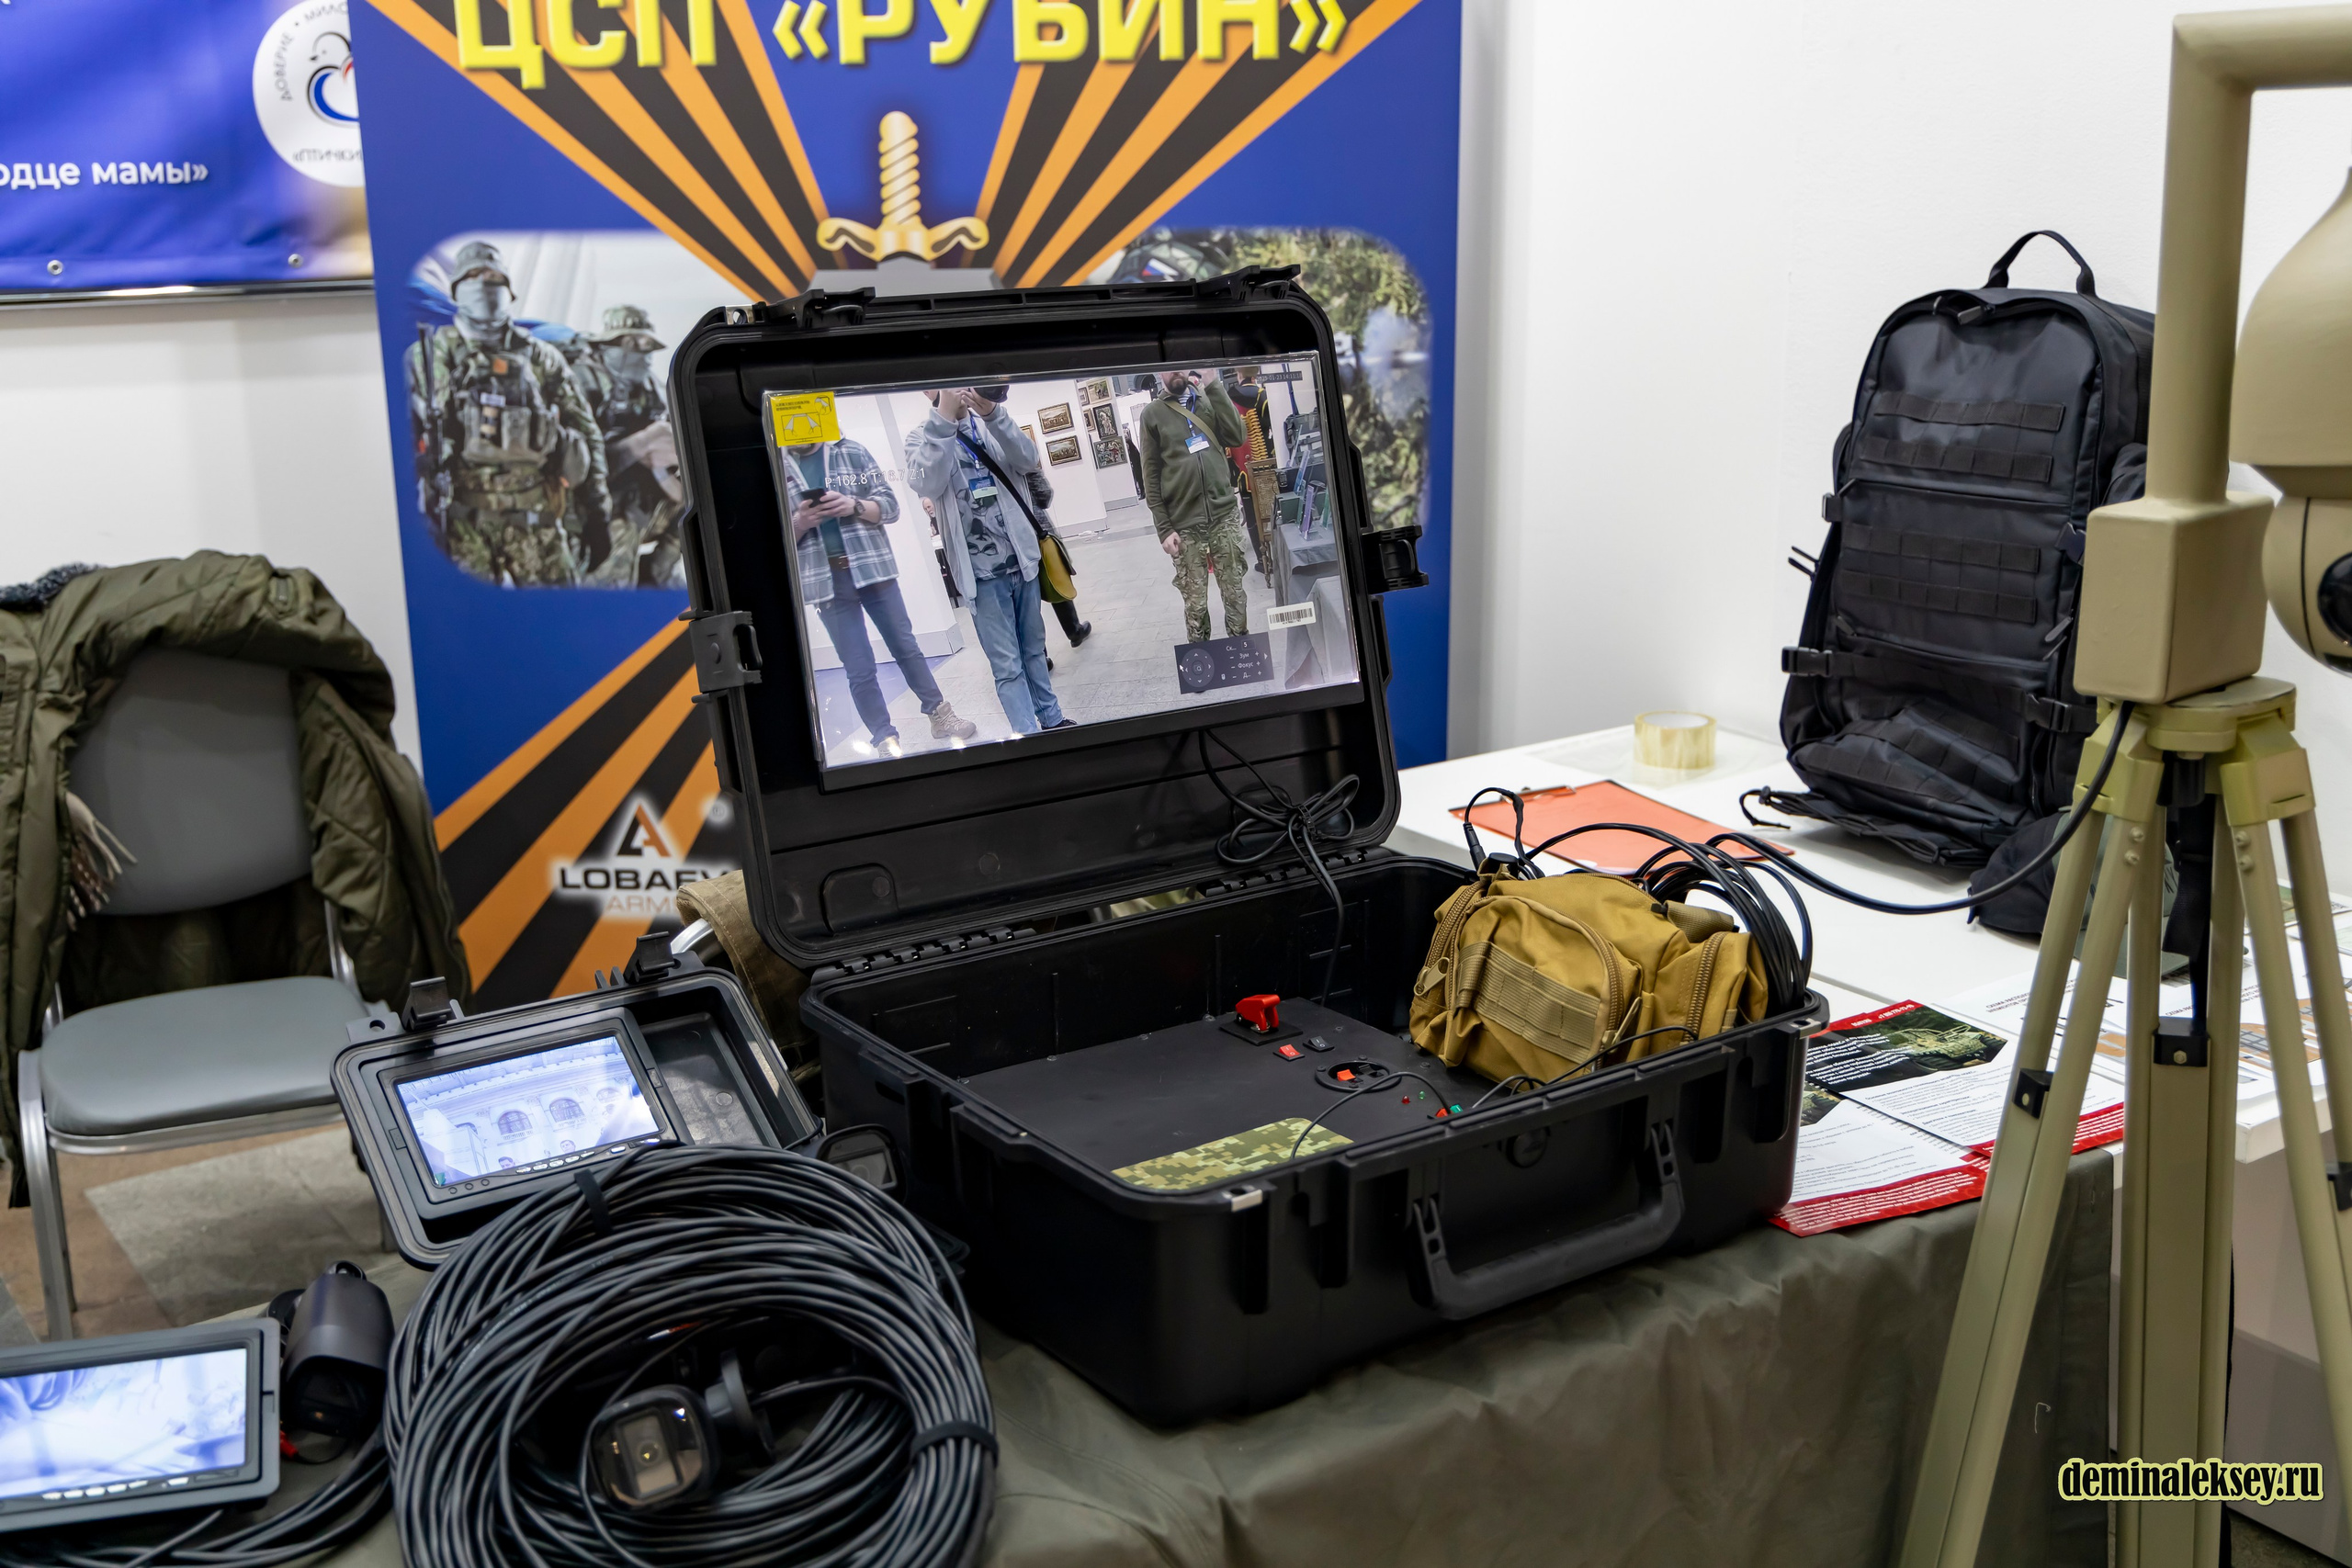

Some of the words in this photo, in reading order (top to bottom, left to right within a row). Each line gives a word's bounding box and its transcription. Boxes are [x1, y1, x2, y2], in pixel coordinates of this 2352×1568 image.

[454, 0, 718, 89] ЦСП
[773, 0, 1348, 66] «РУБИН»
[91, 162, 209, 185] мамы»
[824, 473, 868, 489] P:162.8
[910, 468, 925, 479] Z:1
[560, 867, 729, 891] LOBAE
[605, 896, 677, 913] ARM
